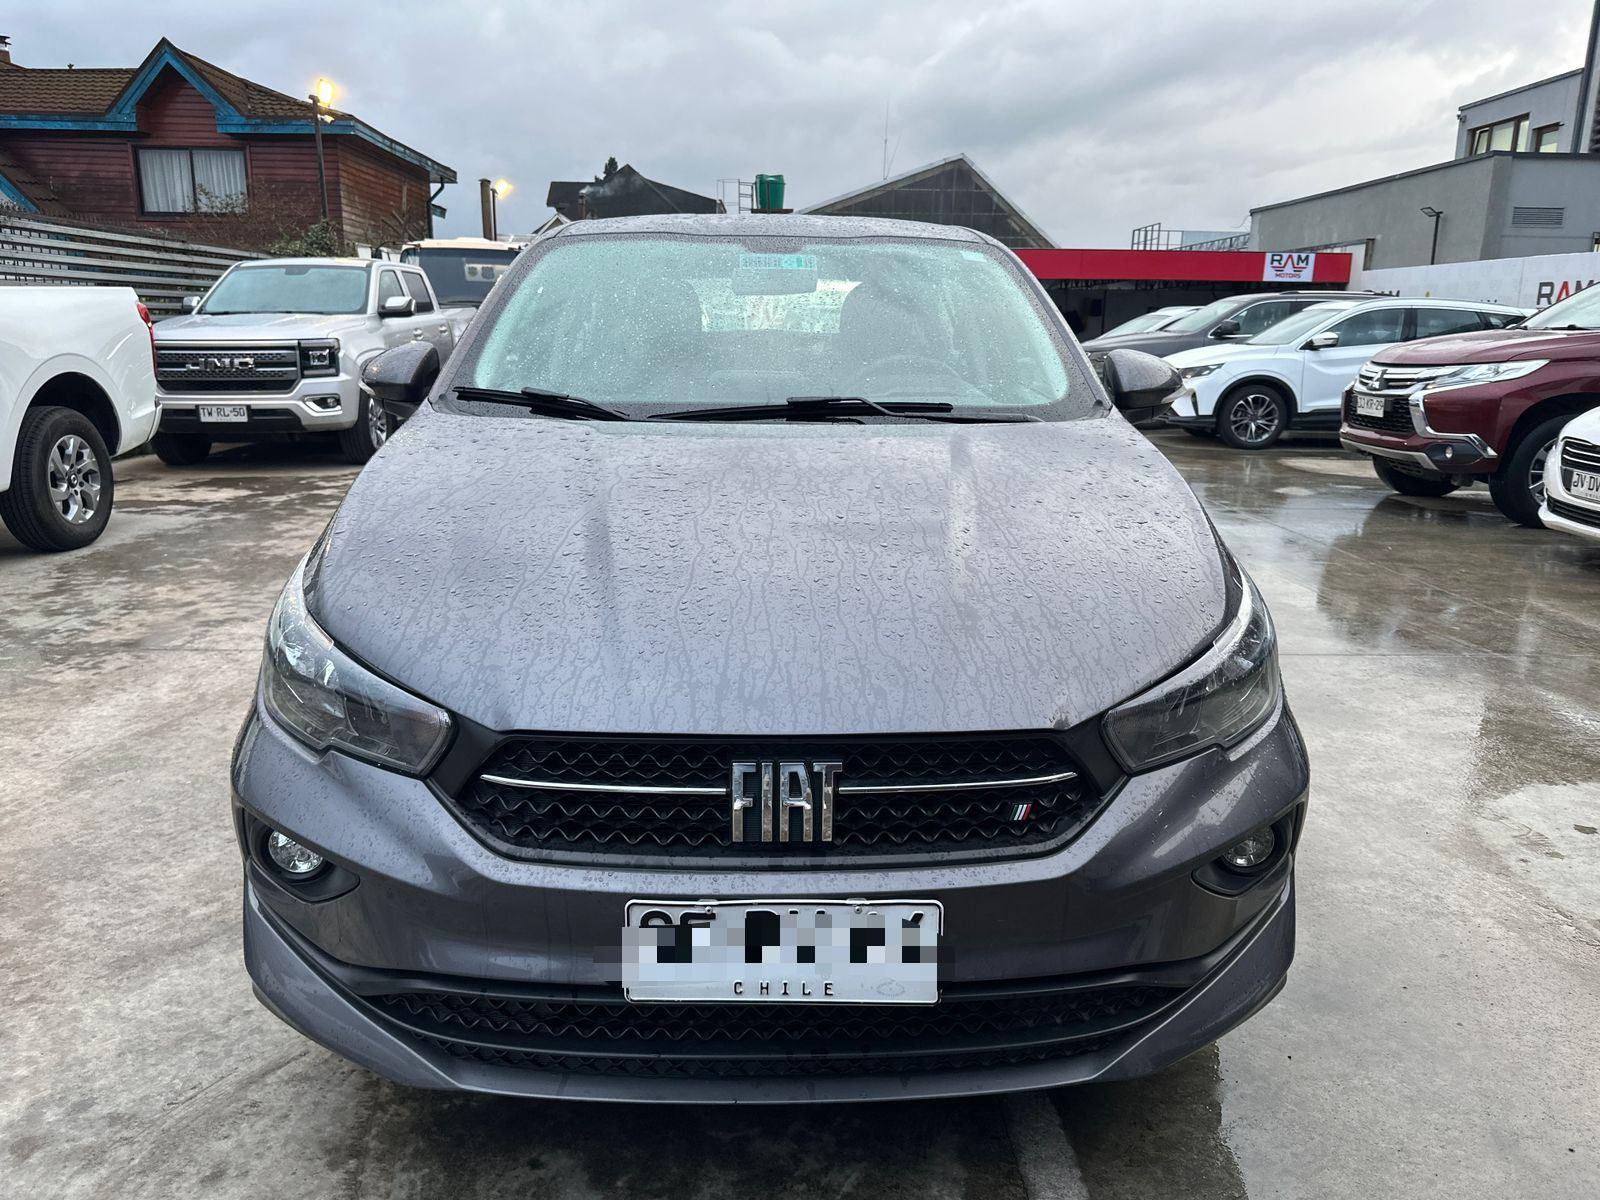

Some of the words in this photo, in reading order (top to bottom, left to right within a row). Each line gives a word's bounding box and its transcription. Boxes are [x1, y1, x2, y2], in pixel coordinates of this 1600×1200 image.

[1271, 254, 1310, 268] RAM
[186, 358, 255, 370] JMC
[732, 762, 842, 842] FIAT
[733, 981, 834, 996] CHILE
